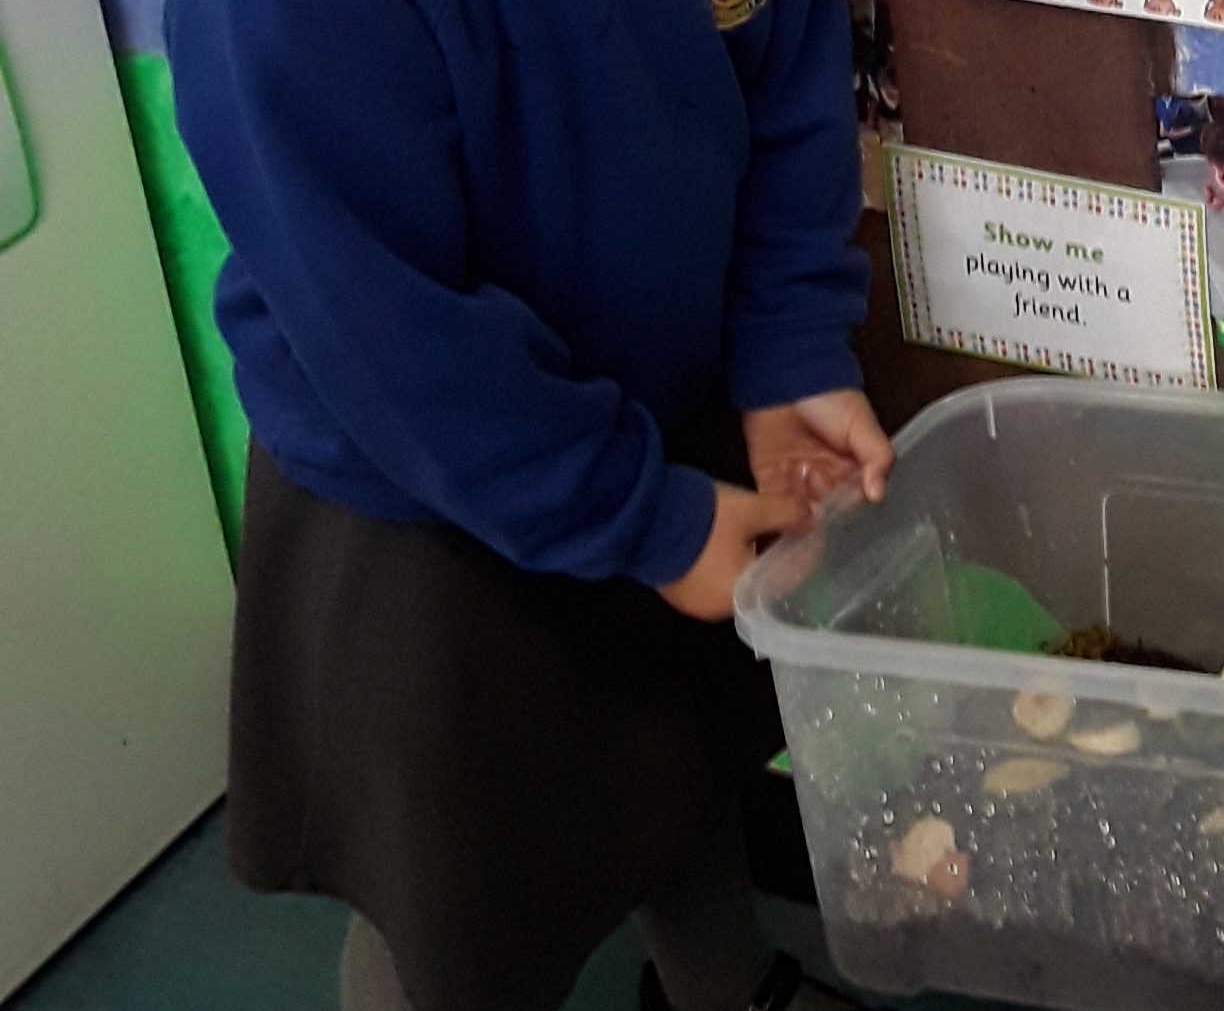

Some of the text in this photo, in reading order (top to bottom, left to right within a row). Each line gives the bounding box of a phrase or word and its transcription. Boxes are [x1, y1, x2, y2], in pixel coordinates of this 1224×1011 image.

[984, 220, 1104, 264] Show me
[966, 253, 1132, 304] playing with a
[1014, 292, 1087, 326] friend.
